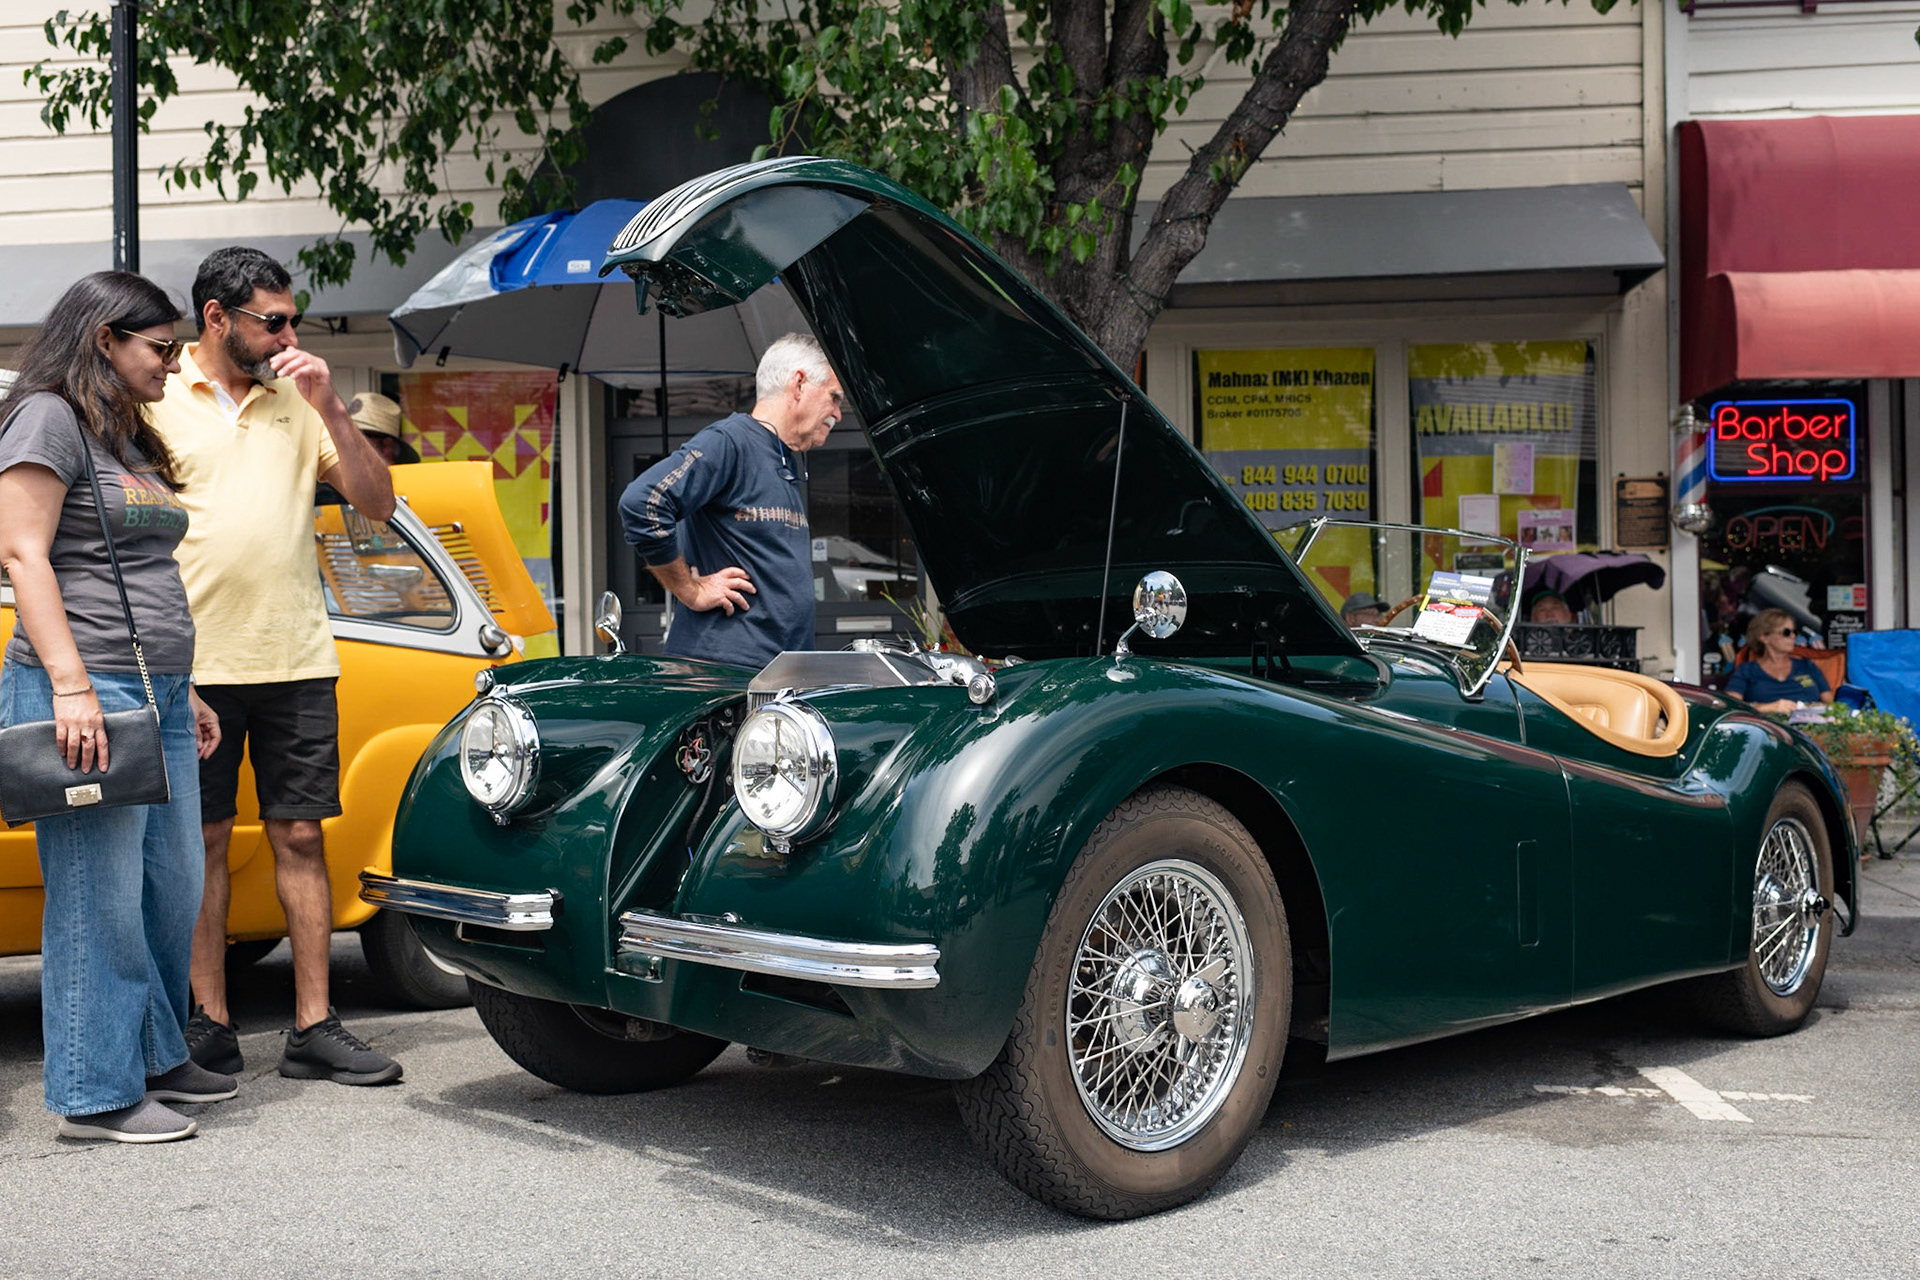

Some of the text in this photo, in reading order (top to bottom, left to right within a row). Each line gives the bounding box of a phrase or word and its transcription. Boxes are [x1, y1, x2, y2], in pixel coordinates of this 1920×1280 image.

[1208, 369, 1371, 388] Mahnaz (MK) Khazen
[1207, 396, 1240, 406] CCIM,
[1243, 395, 1272, 405] CPM,
[1207, 410, 1243, 419] Broker
[1717, 406, 1848, 440] Barber
[1746, 442, 1847, 482] Shop
[1241, 465, 1277, 486] 844
[1283, 465, 1319, 486] 944
[1324, 464, 1369, 486] 0700
[1244, 491, 1369, 511] 408 835 7030
[122, 506, 154, 528] BE
[1726, 516, 1828, 548] OPEN
